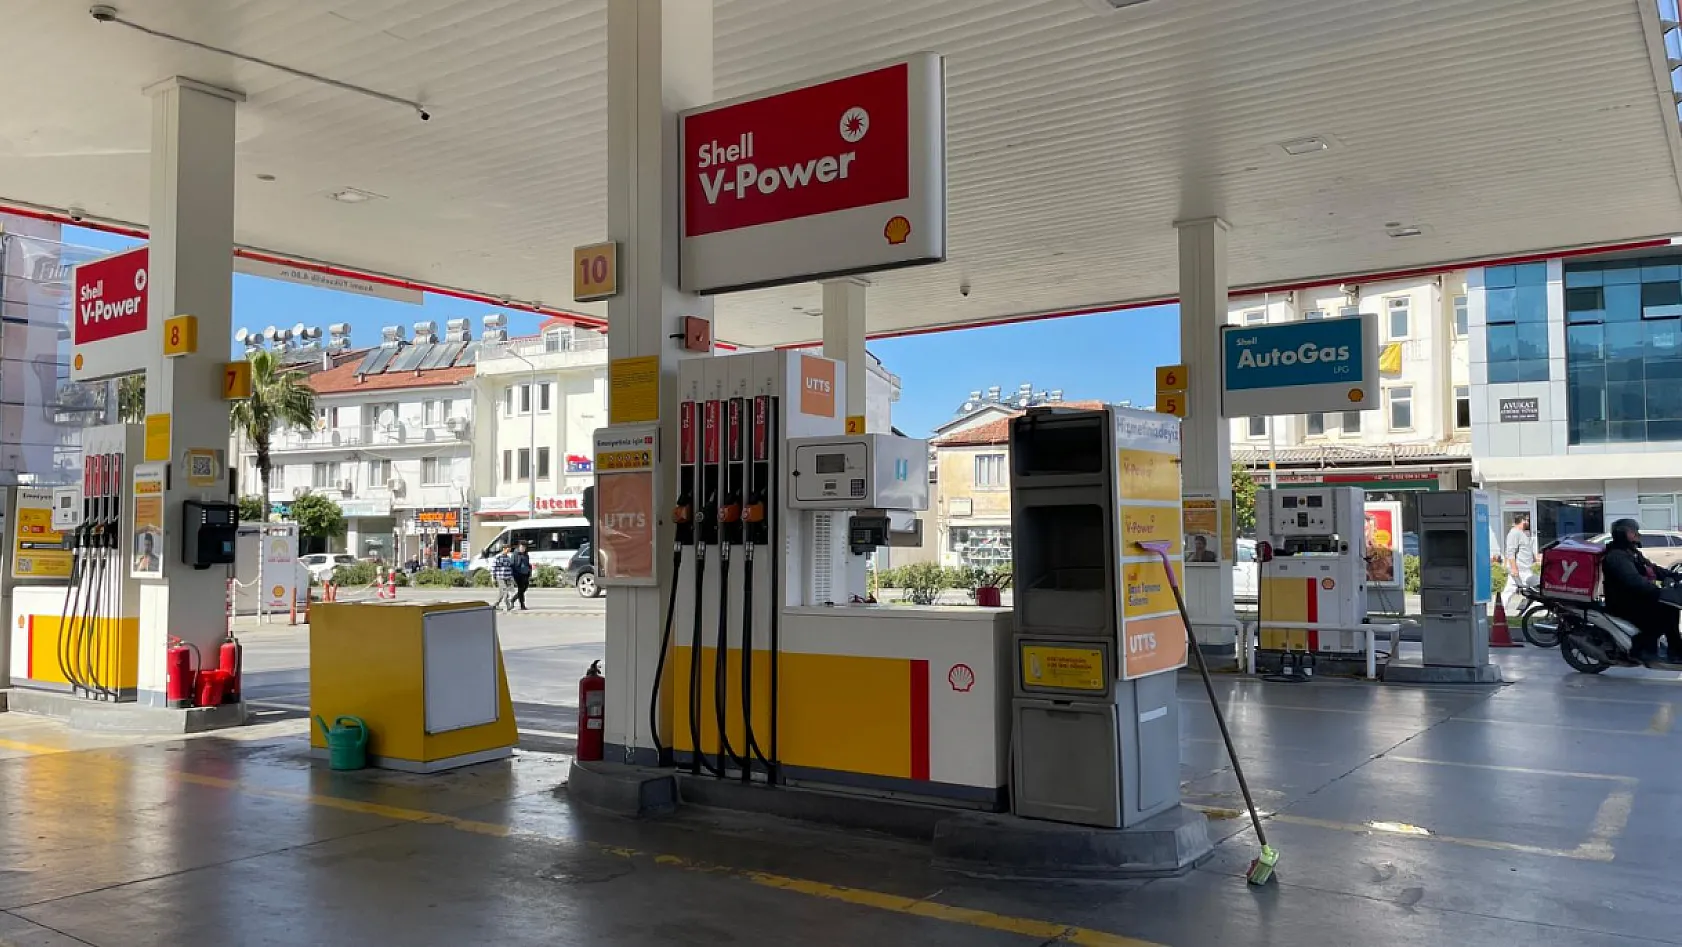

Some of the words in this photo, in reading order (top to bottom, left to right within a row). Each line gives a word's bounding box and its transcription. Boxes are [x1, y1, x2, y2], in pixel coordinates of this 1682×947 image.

[698, 132, 754, 168] Shell
[698, 151, 856, 204] V-Power
[580, 254, 607, 286] 10
[81, 280, 103, 302] Shell
[81, 295, 141, 326] V-Power
[170, 326, 180, 346] 8
[1236, 336, 1258, 346] Shell
[1237, 343, 1350, 369] AutoGas
[1166, 371, 1176, 385] 6
[1333, 365, 1349, 374] LPG
[227, 370, 236, 391] 7
[806, 376, 830, 392] UTTS
[1166, 398, 1176, 413] 5
[848, 420, 856, 432] 2
[604, 512, 646, 528] UTTS
[1125, 521, 1154, 534] V-Power
[1562, 559, 1578, 583] Y
[1130, 632, 1157, 654] UTTS
